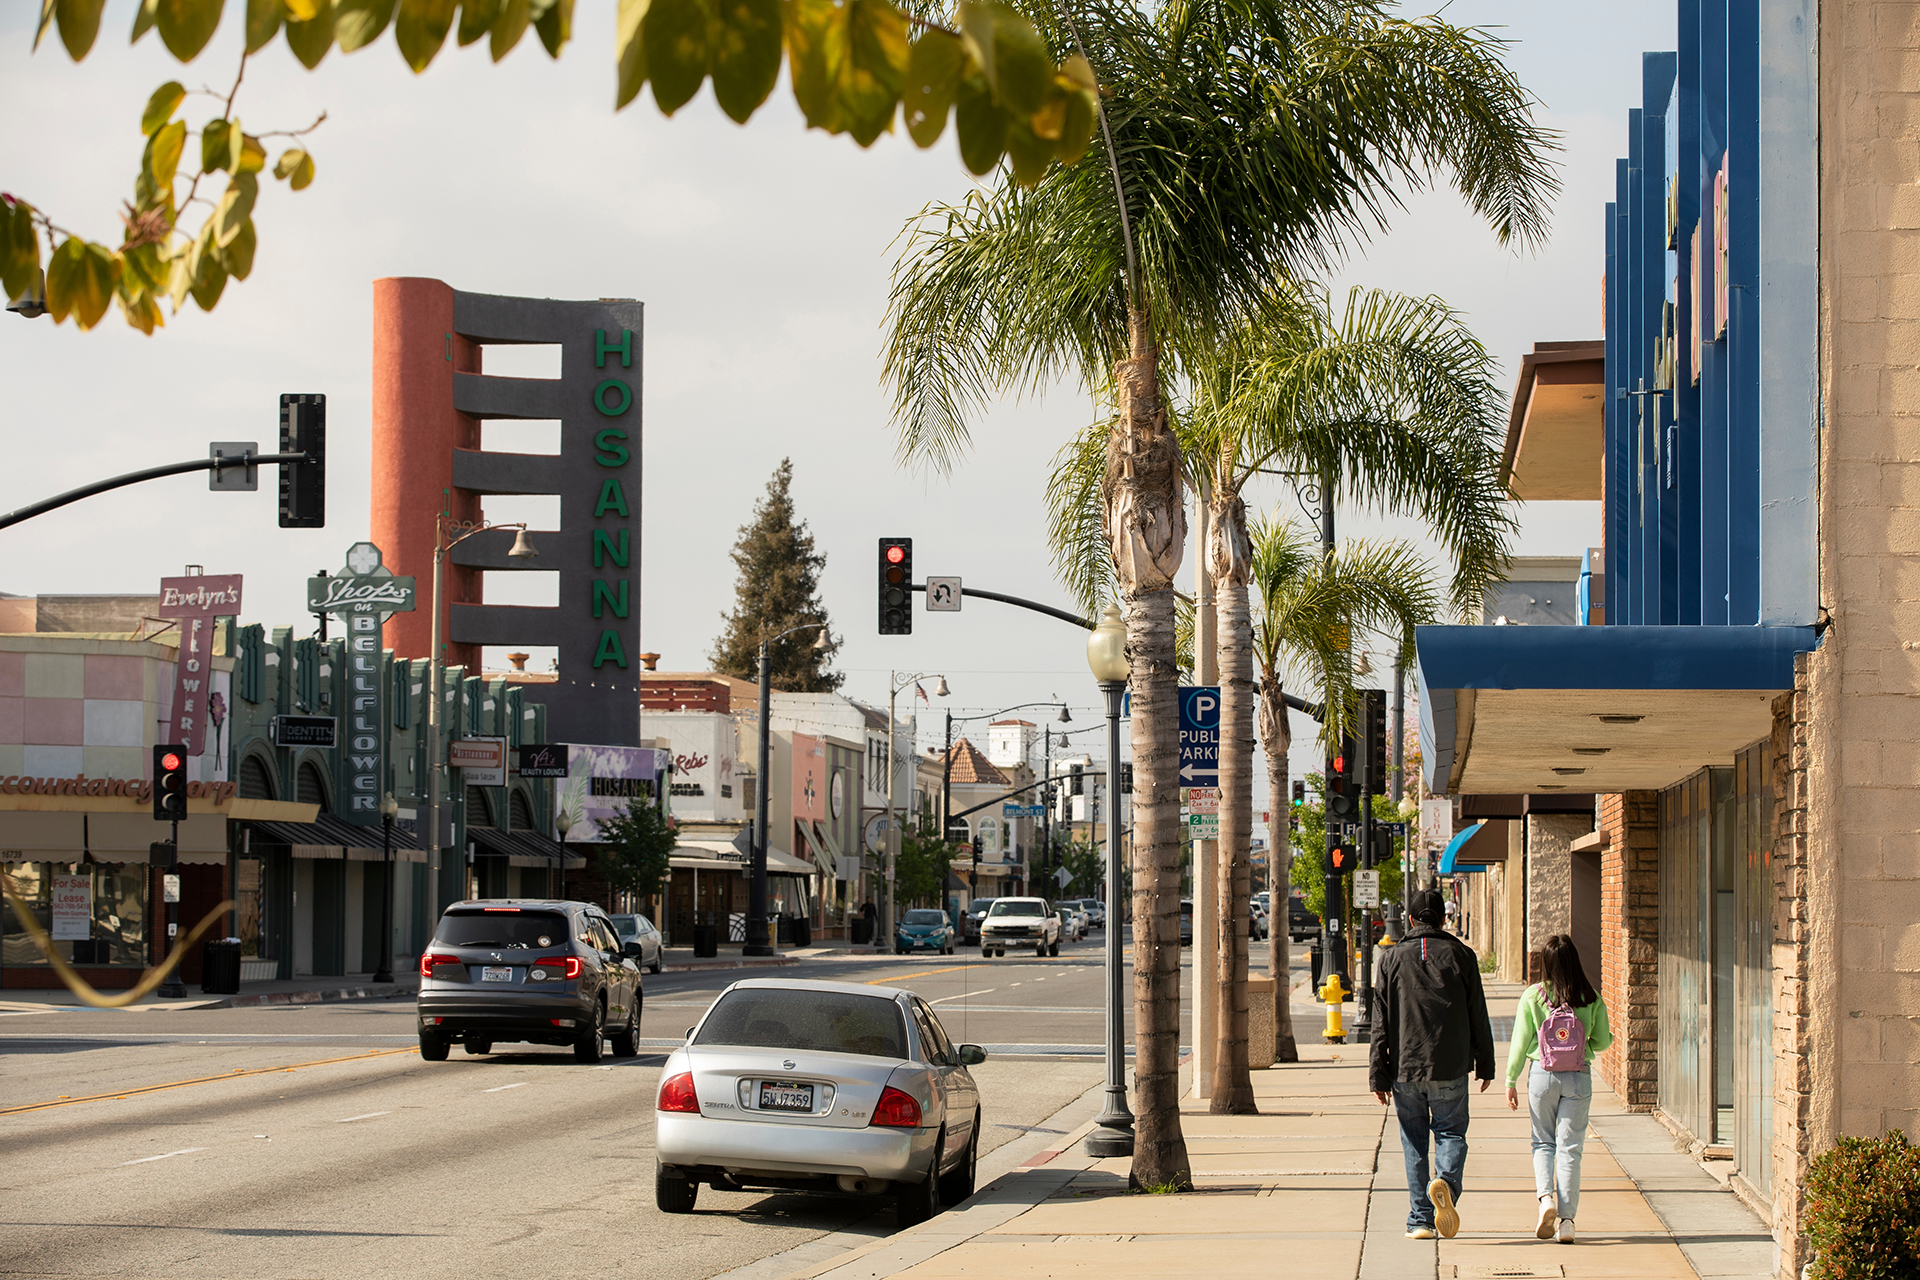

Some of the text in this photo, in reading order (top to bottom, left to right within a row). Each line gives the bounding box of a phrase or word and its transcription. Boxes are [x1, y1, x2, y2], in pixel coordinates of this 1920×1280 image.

[593, 329, 632, 669] HOSANNA
[161, 584, 238, 611] Evelyn's
[310, 578, 412, 608] Shops
[354, 603, 373, 612] on
[180, 619, 202, 751] FLOWERS
[352, 616, 380, 810] BELLFLOWER
[1197, 696, 1216, 721] P
[1179, 730, 1219, 743] PUBL
[1179, 747, 1218, 760] ARKI
[521, 767, 566, 777] BEAUTY LOUNGE
[0, 773, 238, 806] countancy orp
[1190, 791, 1200, 799] NO
[1005, 808, 1043, 816] BELMONT ST
[1193, 816, 1199, 824] 2
[1, 850, 23, 859] 16739
[1362, 872, 1370, 880] NO
[53, 878, 91, 889] For Sale
[58, 893, 85, 903] Lease
[763, 1092, 809, 1108] 5WJZ359
